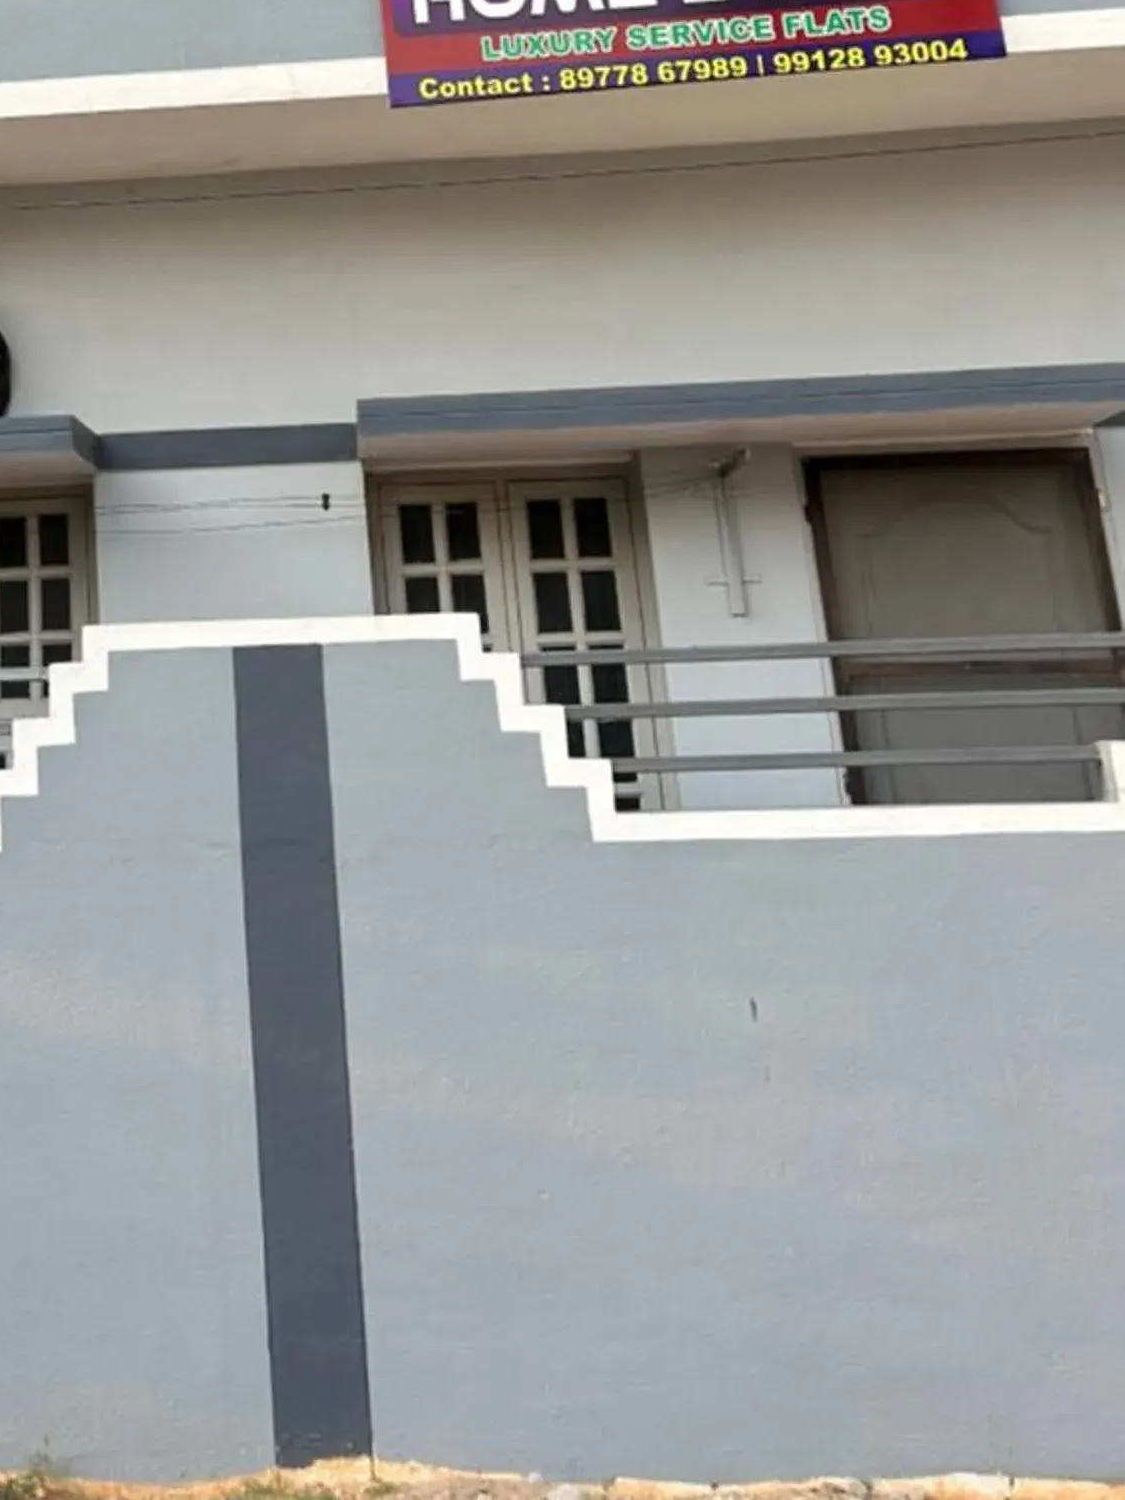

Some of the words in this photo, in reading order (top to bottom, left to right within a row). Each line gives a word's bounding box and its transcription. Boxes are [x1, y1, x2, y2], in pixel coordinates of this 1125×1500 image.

[480, 27, 617, 62] LUXURY
[626, 13, 776, 51] SERVICE
[782, 5, 891, 39] FLATS
[419, 72, 533, 100] Contact
[559, 63, 649, 91] 89778
[657, 55, 748, 83] 67989
[773, 46, 866, 74] 99128
[874, 38, 968, 66] 93004
